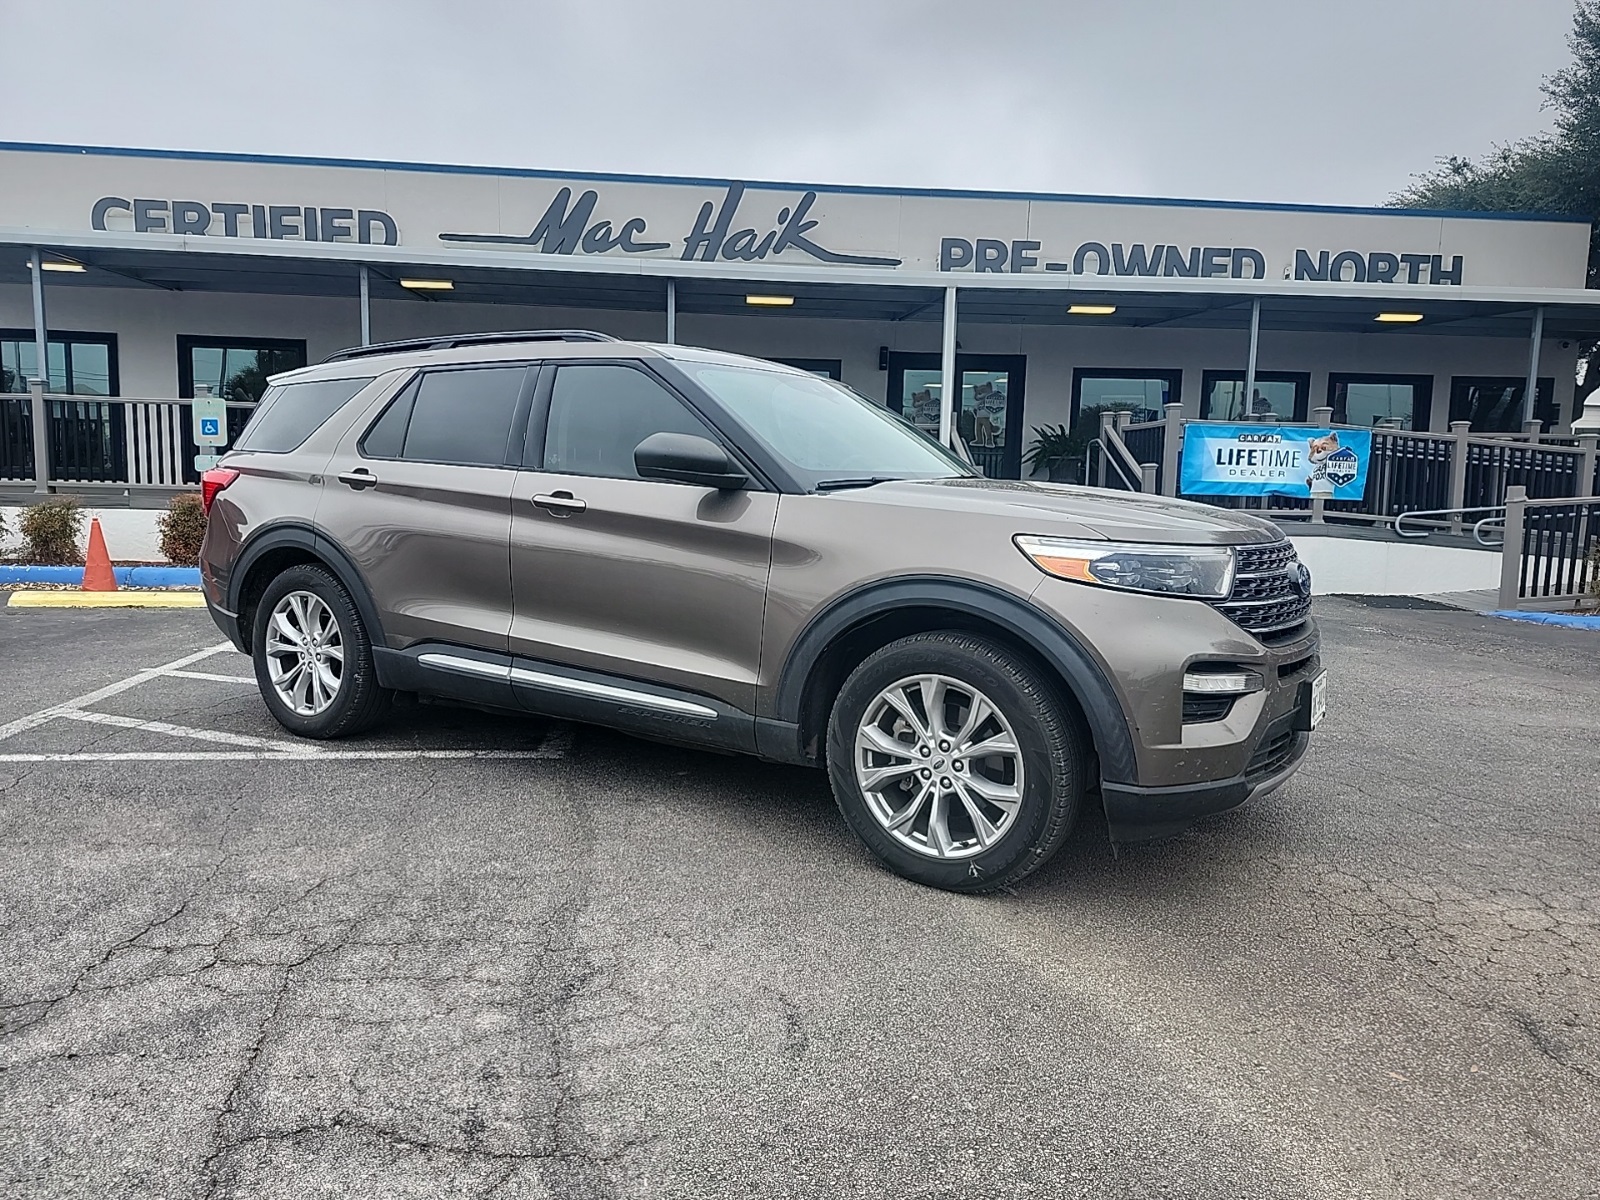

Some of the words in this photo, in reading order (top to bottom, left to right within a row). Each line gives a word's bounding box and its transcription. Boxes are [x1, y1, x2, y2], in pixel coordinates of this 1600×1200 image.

[92, 197, 398, 246] CERTIFIED
[439, 187, 670, 255] Mac
[680, 181, 902, 265] Haik
[940, 237, 1266, 279] PRE-OWNED
[1295, 249, 1464, 286] NORTH
[1238, 434, 1282, 443] CARFAX
[1216, 448, 1302, 468] LIFETIME
[1229, 469, 1286, 477] DEALER
